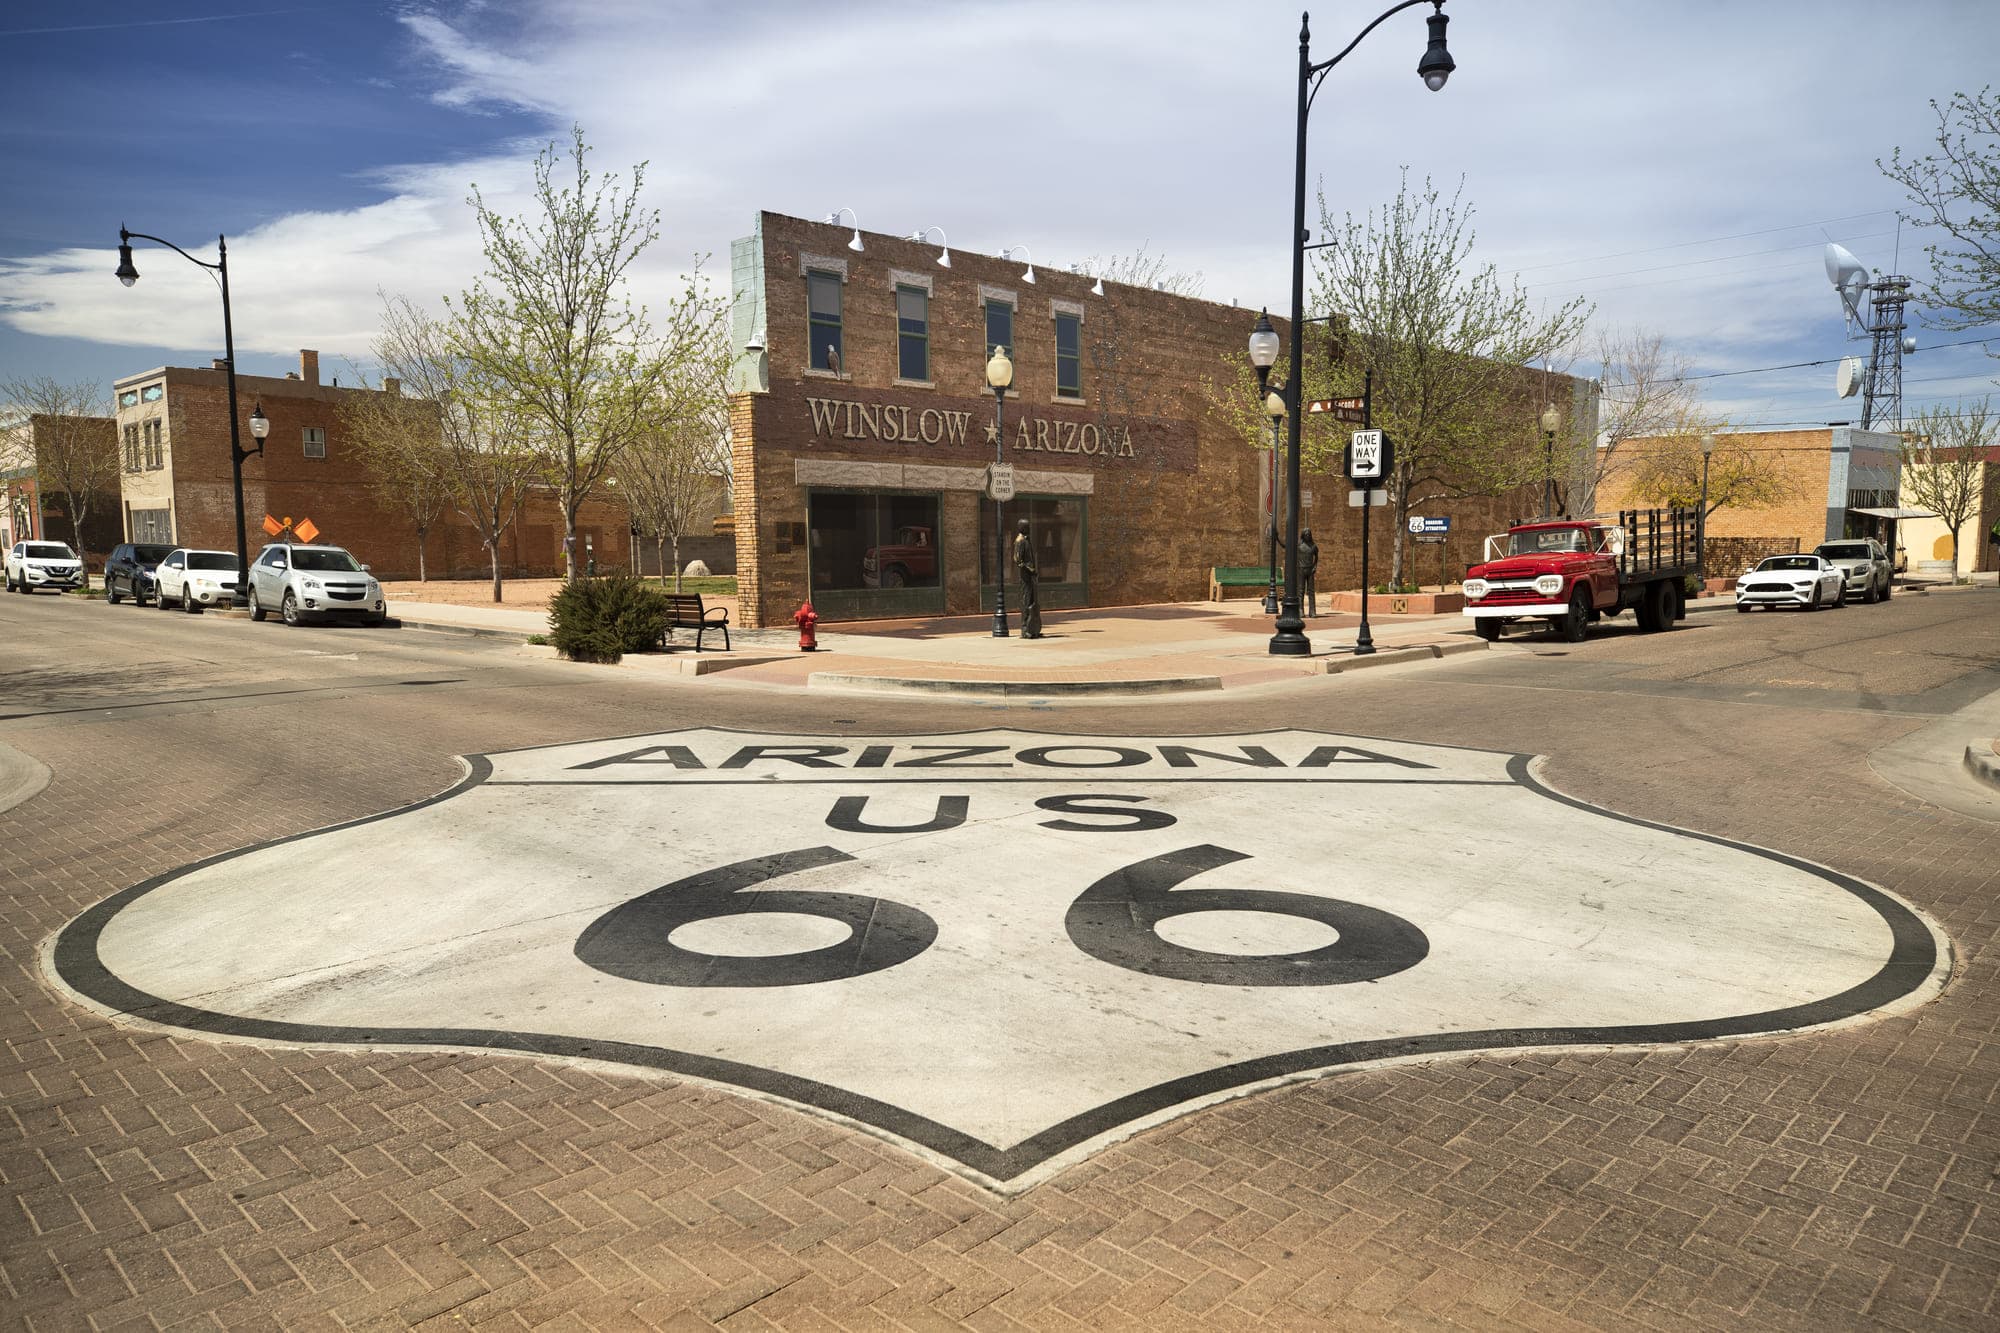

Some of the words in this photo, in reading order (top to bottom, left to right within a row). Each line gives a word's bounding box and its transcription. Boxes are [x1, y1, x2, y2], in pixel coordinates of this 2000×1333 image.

[806, 397, 972, 445] WINSLOW
[1013, 416, 1135, 458] ARIZONA
[1356, 434, 1377, 446] ONE
[1355, 447, 1377, 458] WAY
[1411, 522, 1422, 531] 66
[565, 745, 1437, 769] ARIZONA
